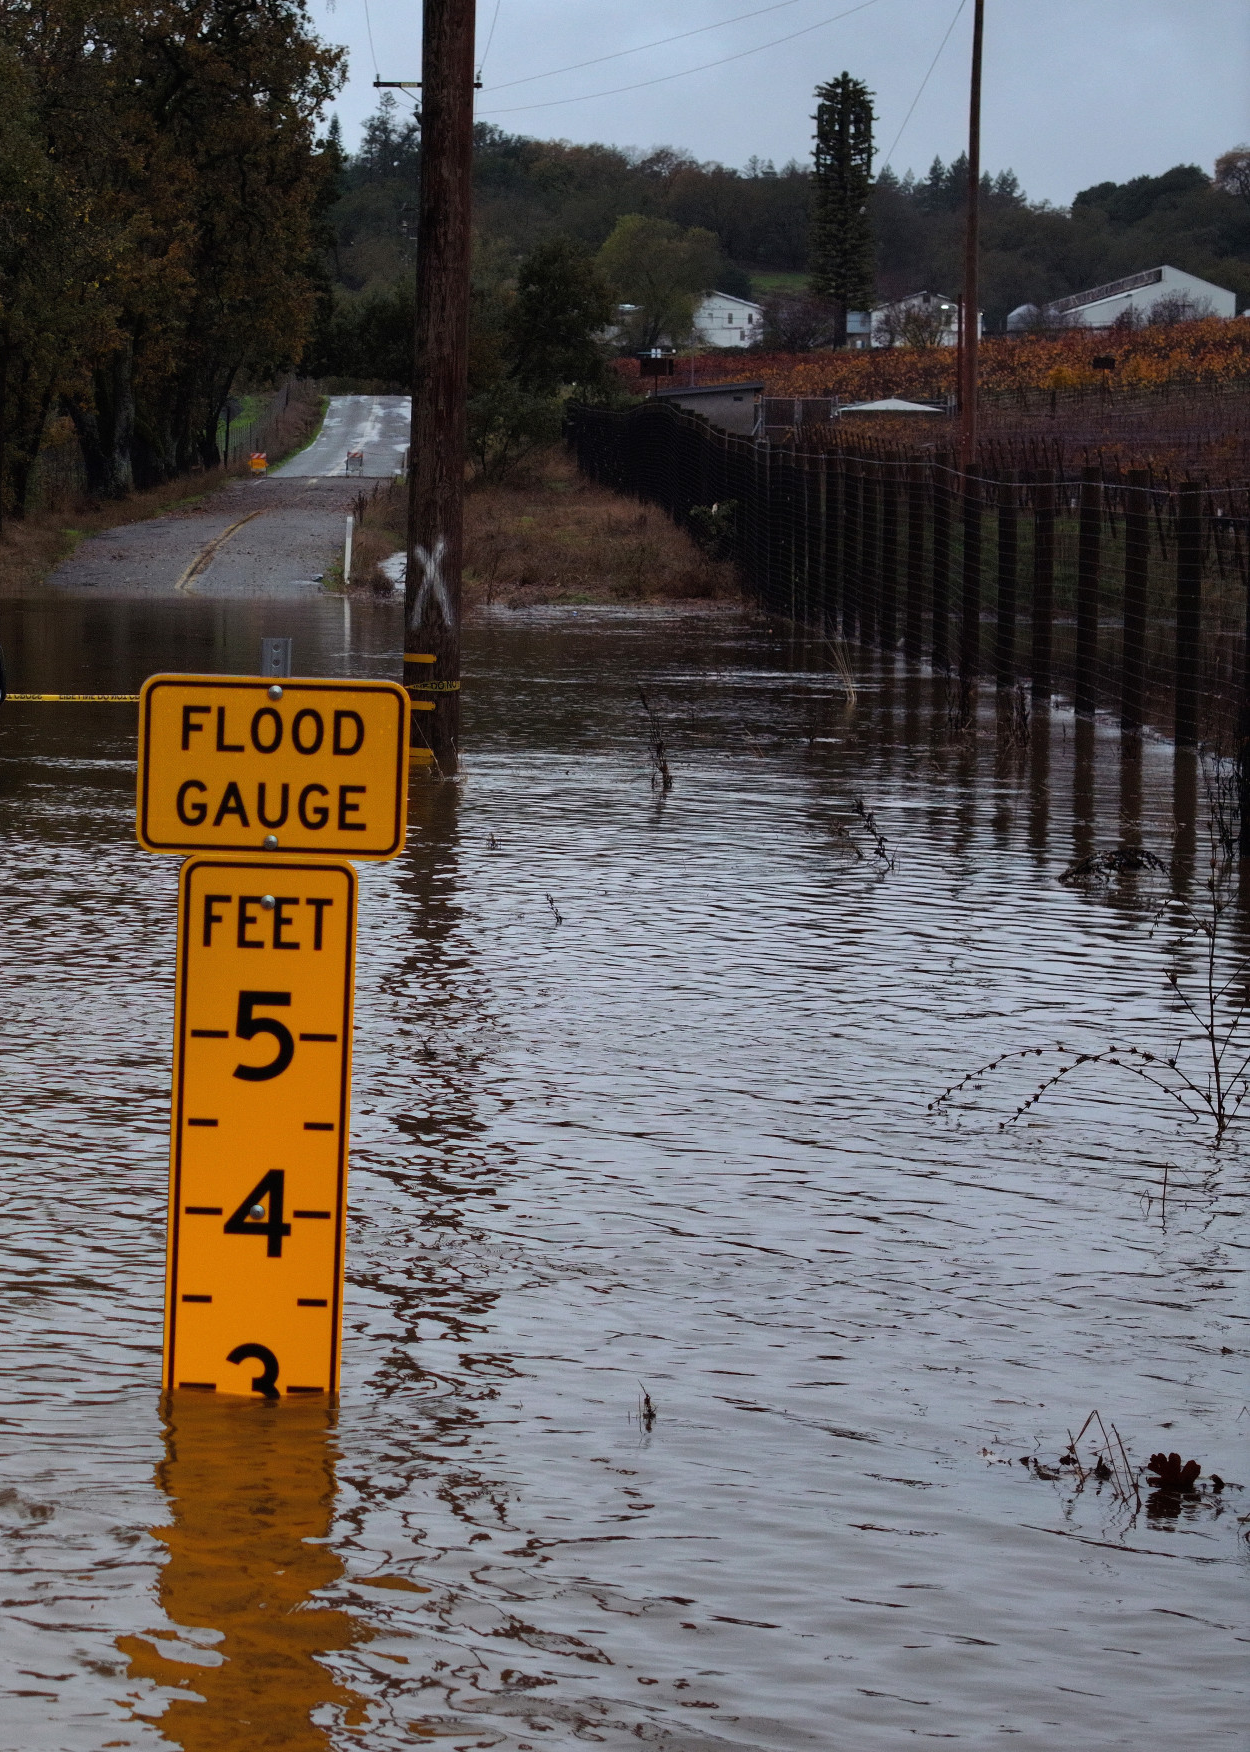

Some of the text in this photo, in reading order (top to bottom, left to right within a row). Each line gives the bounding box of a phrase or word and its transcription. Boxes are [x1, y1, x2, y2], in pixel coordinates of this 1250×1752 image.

[181, 706, 365, 756] FLOOD
[176, 780, 367, 831] GAUGE
[203, 895, 334, 951] FEET
[232, 990, 294, 1081] 5
[223, 1169, 291, 1258] 4
[226, 1342, 280, 1399] 3
